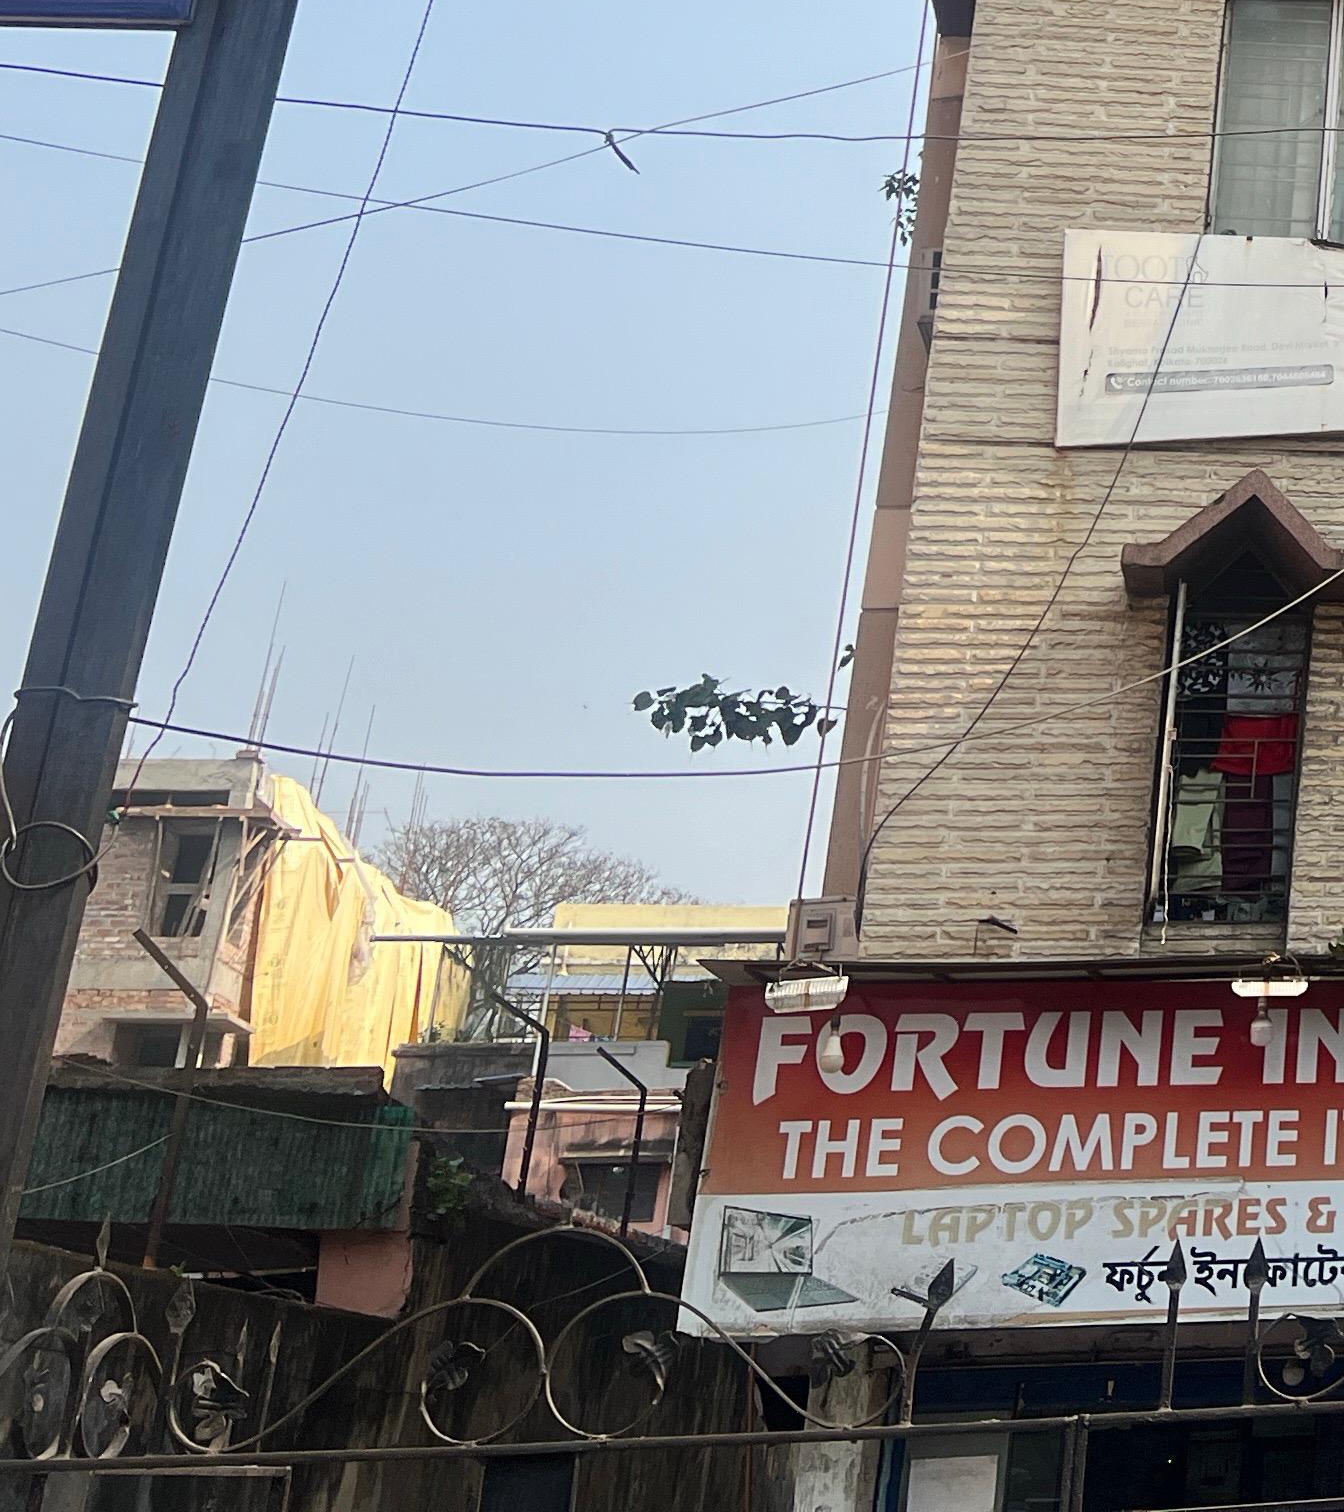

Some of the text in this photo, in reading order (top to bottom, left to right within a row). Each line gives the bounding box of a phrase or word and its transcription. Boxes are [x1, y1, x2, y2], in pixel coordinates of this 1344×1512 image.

[752, 1008, 1226, 1106] FORTUNE
[779, 1117, 904, 1180] THE
[927, 1109, 1301, 1176] COMPLETE
[902, 1198, 1094, 1248] LAPTOP
[1111, 1194, 1287, 1241] SPARES
[1305, 1196, 1337, 1234] &
